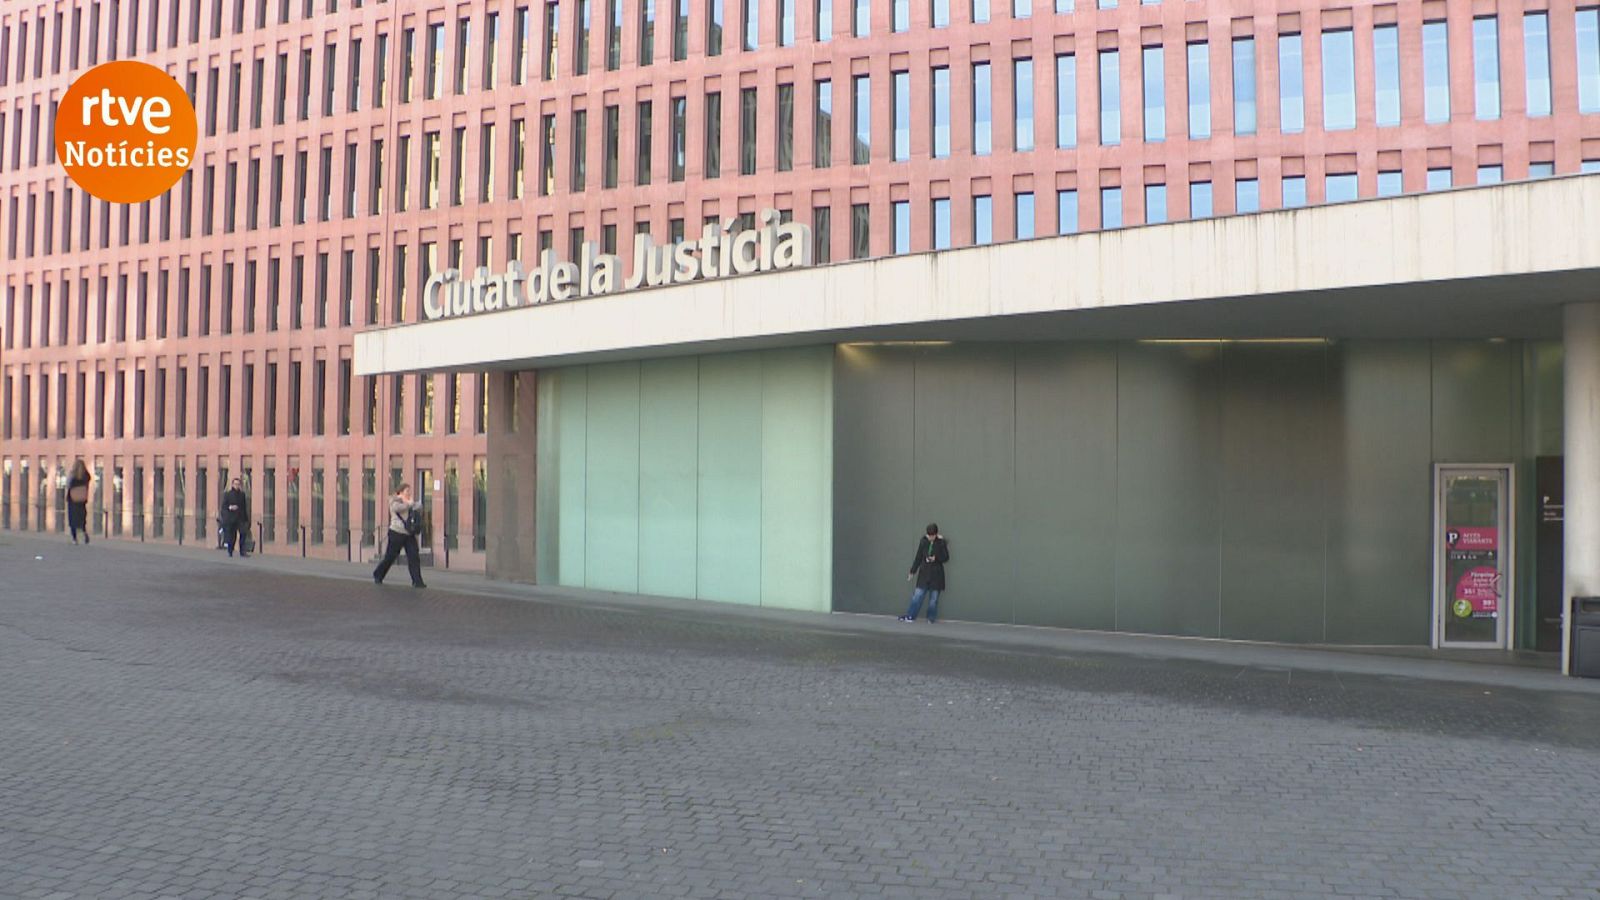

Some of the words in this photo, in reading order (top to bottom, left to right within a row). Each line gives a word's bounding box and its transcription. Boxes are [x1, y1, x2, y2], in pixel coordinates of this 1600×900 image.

[423, 260, 522, 320] Ciutat
[527, 248, 577, 303] de
[580, 240, 618, 296] la
[625, 208, 808, 289] Justícia
[1449, 532, 1458, 544] P
